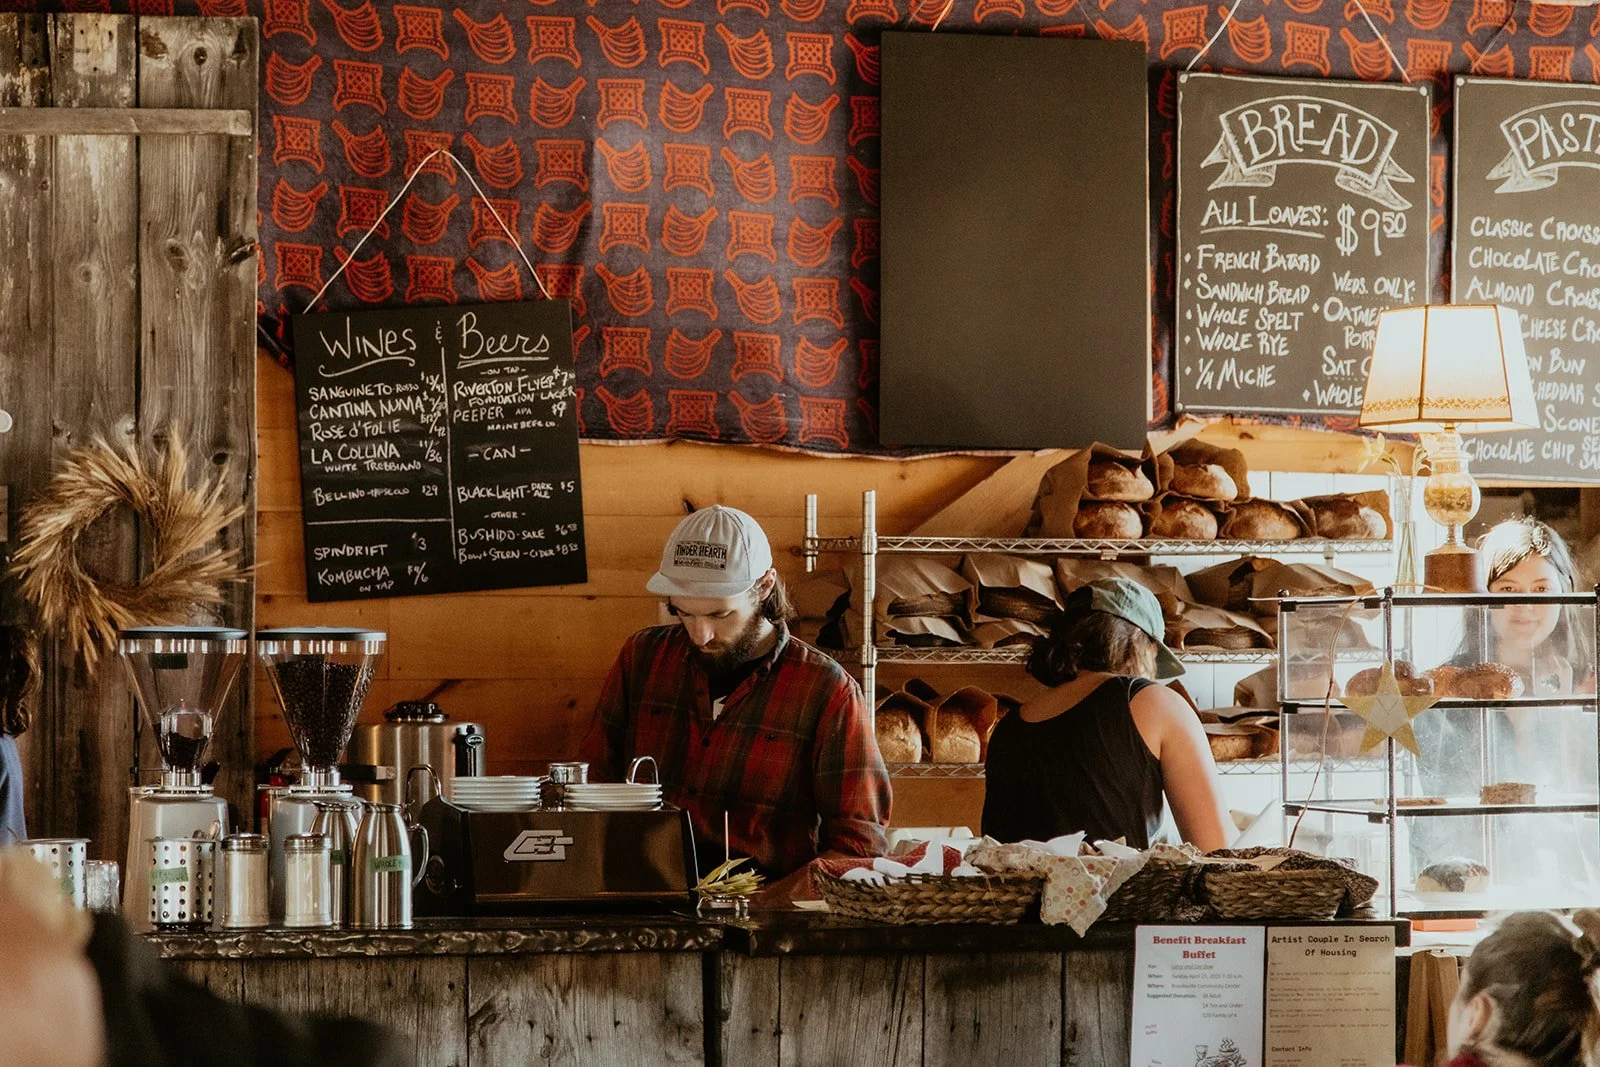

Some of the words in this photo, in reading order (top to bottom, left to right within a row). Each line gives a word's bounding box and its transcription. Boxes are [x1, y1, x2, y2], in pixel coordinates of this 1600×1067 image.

[1238, 102, 1379, 165] BREAD
[1511, 113, 1600, 167] PAST
[1201, 199, 1242, 226] ALL
[1248, 196, 1328, 227] LOAVES:
[1470, 216, 1534, 238] CLASSIC
[1197, 244, 1260, 272] FRENCH
[1262, 243, 1321, 274] BATARD
[1469, 246, 1560, 275] CHOCOLATE
[1196, 273, 1263, 304] SANDWICH
[1266, 280, 1310, 305] BREAD
[1333, 271, 1368, 294] WEDS.
[1465, 276, 1534, 306] ALMOND
[1546, 280, 1600, 310] CROIS
[1196, 302, 1250, 328] WHOLE
[1255, 307, 1304, 332] SPELT
[1323, 296, 1389, 327] OATME
[456, 311, 550, 360] Beers
[1196, 327, 1253, 351] WHOLE
[1257, 331, 1289, 356] RYE
[1216, 357, 1276, 390] MICHE
[1548, 347, 1586, 375] BUN
[453, 380, 513, 402] RIVERTON
[518, 374, 556, 394] FLYER
[540, 385, 577, 400] LAGER
[309, 399, 377, 420] CANTINA
[453, 406, 505, 424] PEEPER
[515, 407, 533, 416] APA
[551, 401, 567, 418] $9
[311, 447, 333, 465] LA
[1461, 437, 1536, 464] CHOCOLATE
[314, 543, 388, 561] SPINDRIFT
[488, 547, 520, 561] STERN
[317, 565, 390, 586] KOMBUCHA
[1152, 936, 1193, 945] Benefit
[1194, 936, 1247, 945] Breakfast
[1271, 935, 1303, 944] Artist
[1307, 935, 1339, 945] Couple
[1359, 935, 1391, 943] Search
[1304, 949, 1316, 957] Of
[1320, 949, 1357, 958] Housing
[1182, 950, 1217, 959] Buffet
